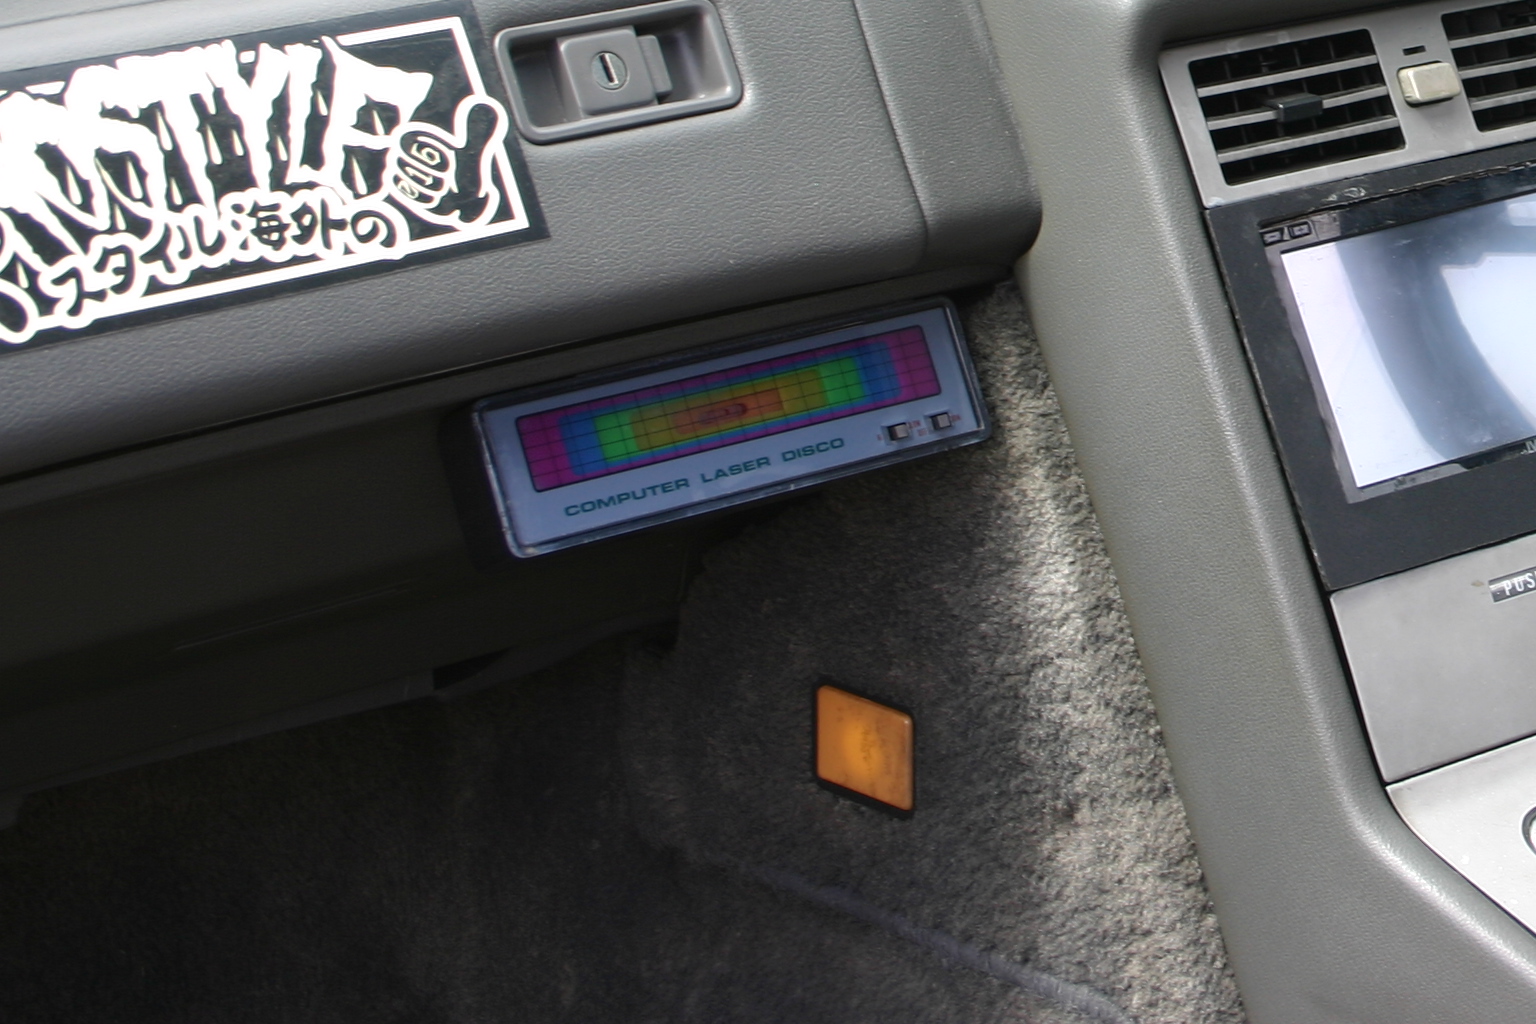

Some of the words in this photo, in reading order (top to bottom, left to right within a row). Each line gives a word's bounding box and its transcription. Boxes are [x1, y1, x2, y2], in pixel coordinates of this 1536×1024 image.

[564, 477, 691, 518] COMPUTER
[701, 454, 771, 485] LASER
[782, 437, 846, 463] DISCO
